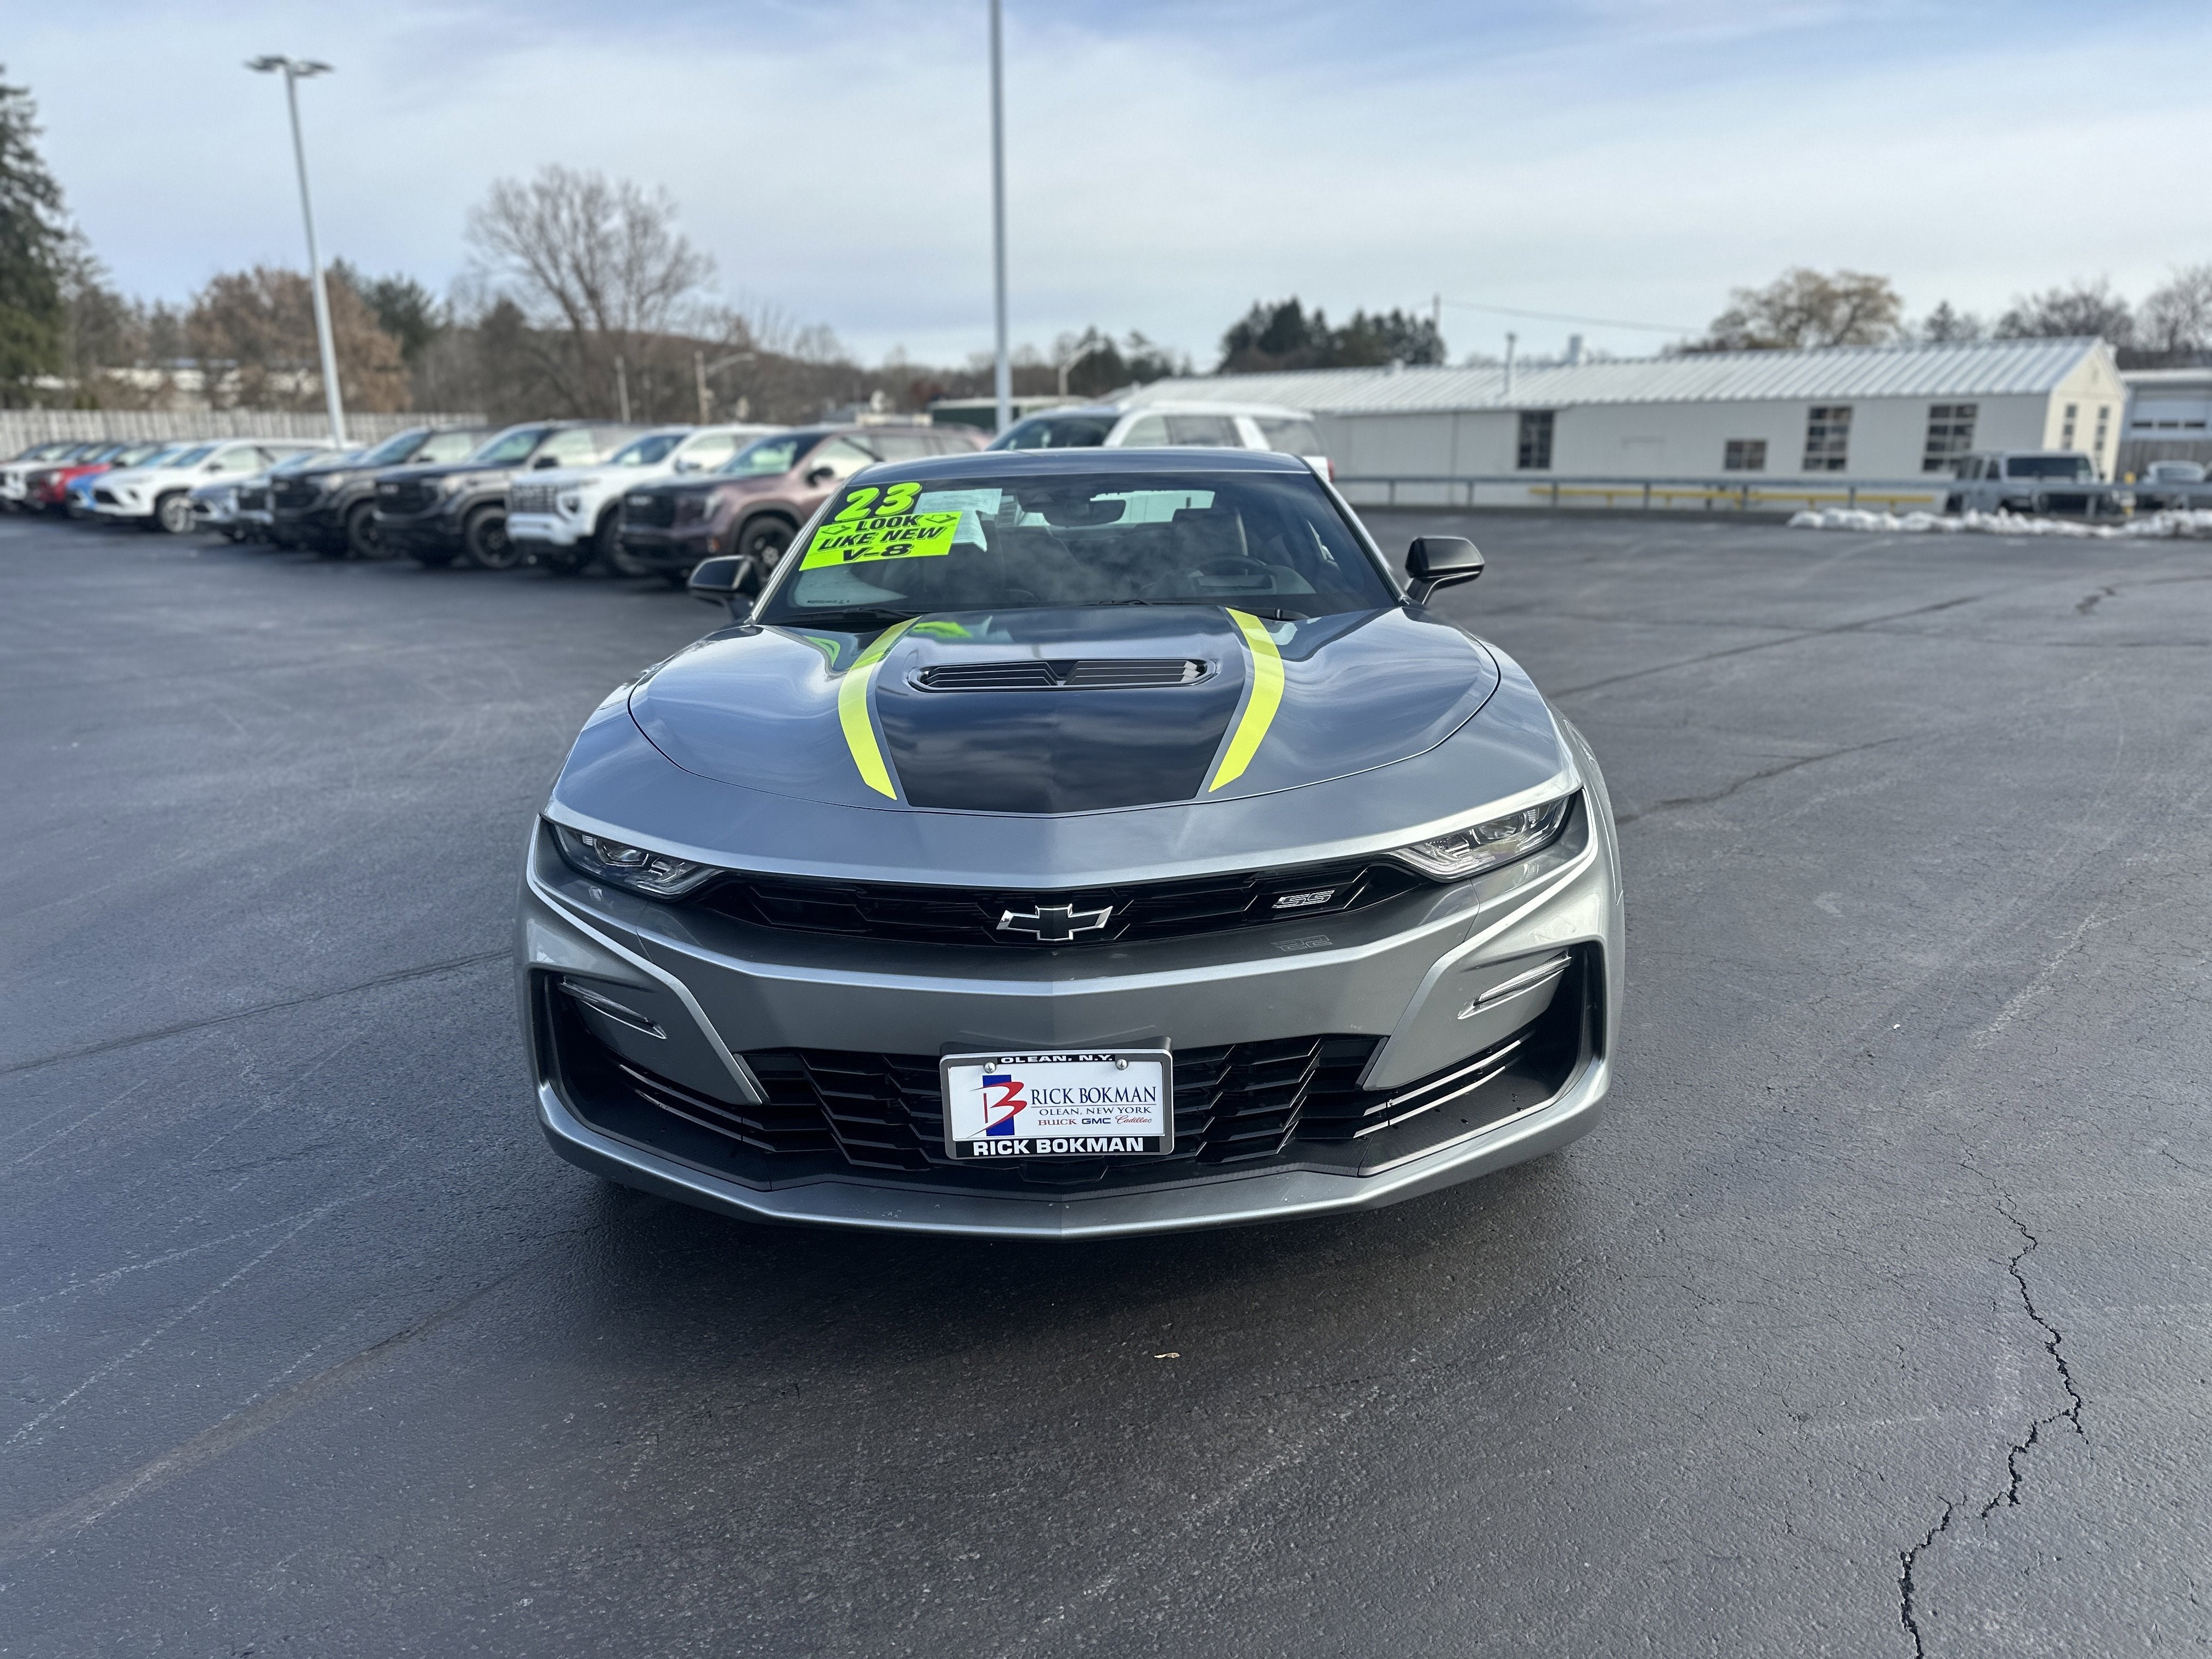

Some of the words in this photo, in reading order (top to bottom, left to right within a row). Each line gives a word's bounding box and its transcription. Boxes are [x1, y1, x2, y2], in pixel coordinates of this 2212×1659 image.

[834, 482, 923, 523] 23
[855, 514, 924, 533] LOOK
[817, 532, 877, 551] LIKE
[880, 526, 948, 543] NEW
[843, 543, 915, 562] V-8
[1271, 889, 1335, 909] SS
[1001, 1055, 1072, 1063] OLEAN,
[1030, 1088, 1075, 1105] RICK
[1079, 1086, 1156, 1103] BOKMAN
[1039, 1108, 1082, 1116] OLEAN,
[1115, 1114, 1152, 1125] Cadillac
[973, 1138, 1031, 1156] RICK
[1036, 1136, 1144, 1154] BOKMAN
